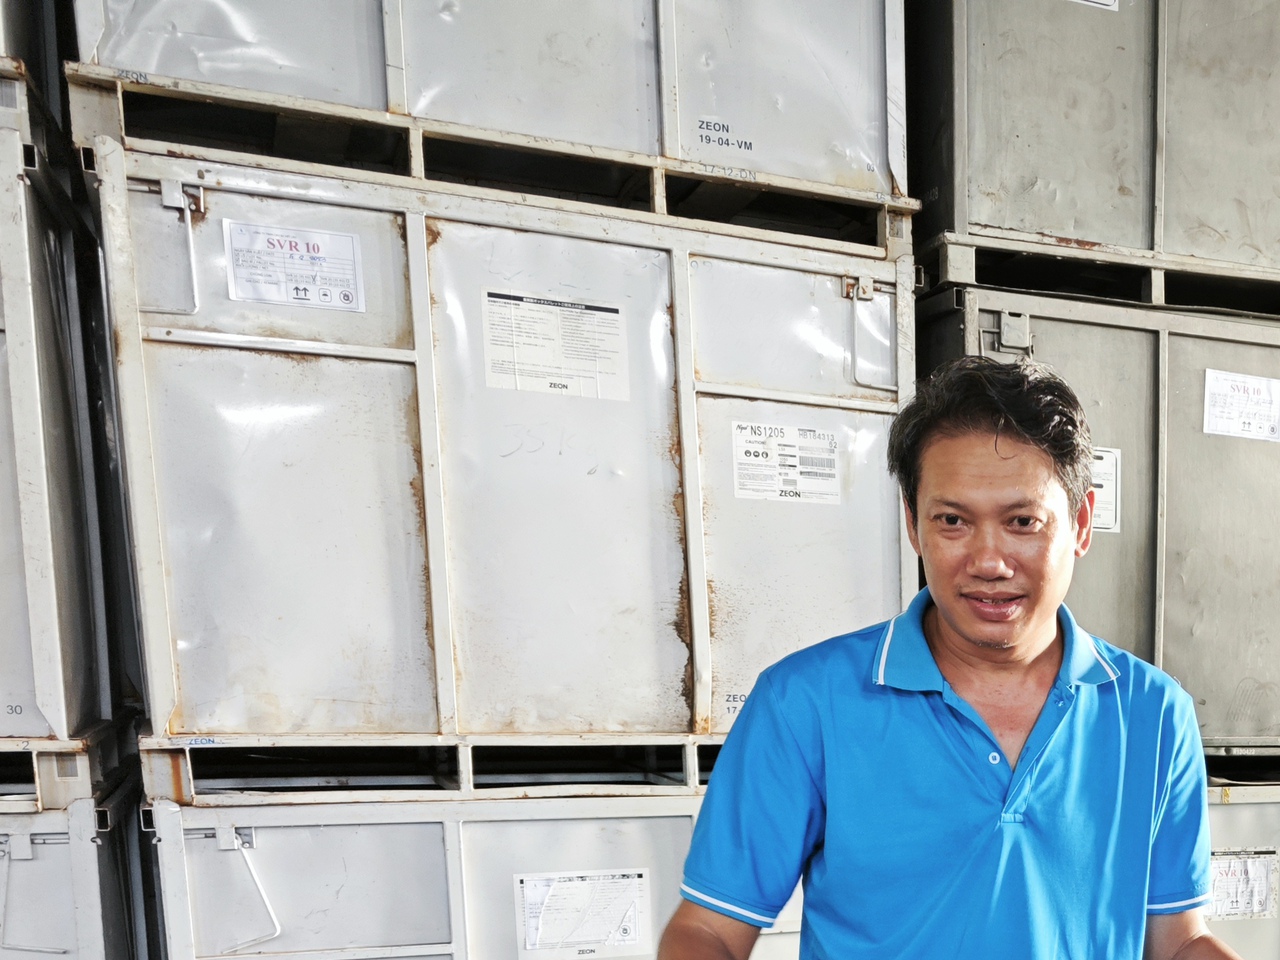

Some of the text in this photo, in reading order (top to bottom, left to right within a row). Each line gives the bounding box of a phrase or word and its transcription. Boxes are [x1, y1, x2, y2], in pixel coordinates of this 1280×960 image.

[698, 120, 729, 133] ZEON
[699, 134, 752, 151] 19-04-VM
[266, 238, 320, 254] SVR 10
[548, 382, 569, 390] ZEON
[1230, 384, 1261, 396] SVR 10
[750, 425, 785, 438] NS1205
[779, 490, 801, 498] ZEON
[6, 704, 23, 715] 30
[21, 740, 30, 751] 2
[1219, 868, 1249, 877] SVR 10
